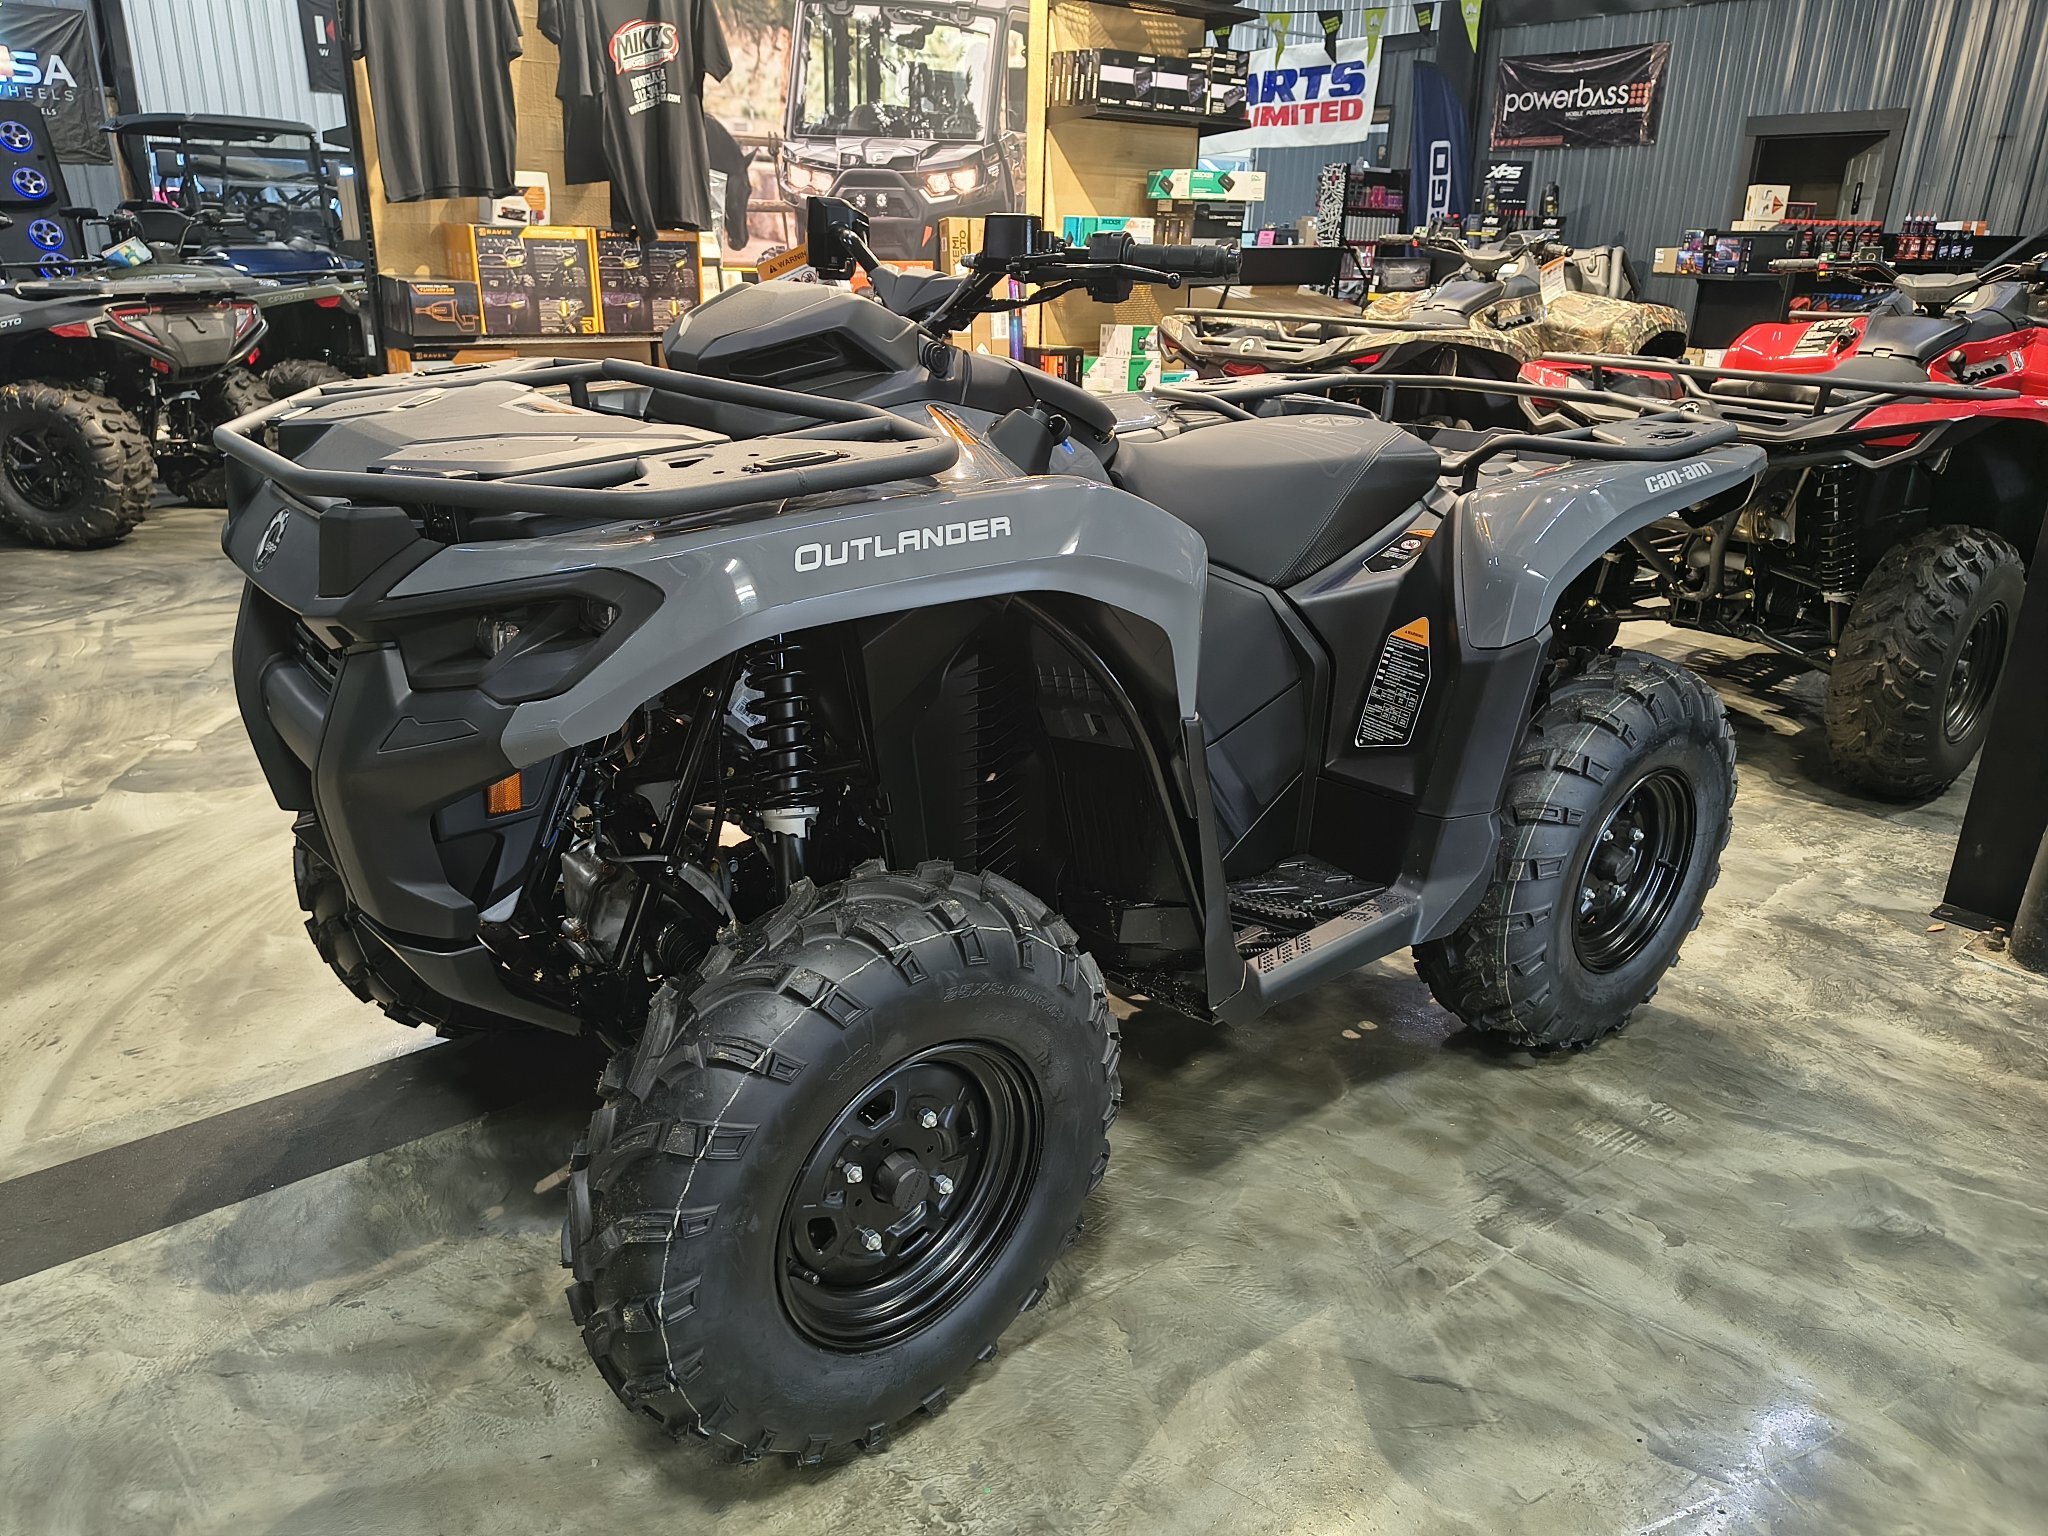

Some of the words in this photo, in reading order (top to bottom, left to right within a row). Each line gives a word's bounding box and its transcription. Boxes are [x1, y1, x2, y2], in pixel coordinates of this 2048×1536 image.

[5, 50, 77, 87] SA
[0, 85, 74, 102] HEELS
[1503, 79, 1629, 121] powerbass
[1430, 140, 1451, 224] GO
[1485, 163, 1524, 179] XPS
[777, 249, 807, 268] WARNIN
[1644, 461, 1713, 494] can-am
[794, 515, 1012, 573] OUTLANDER
